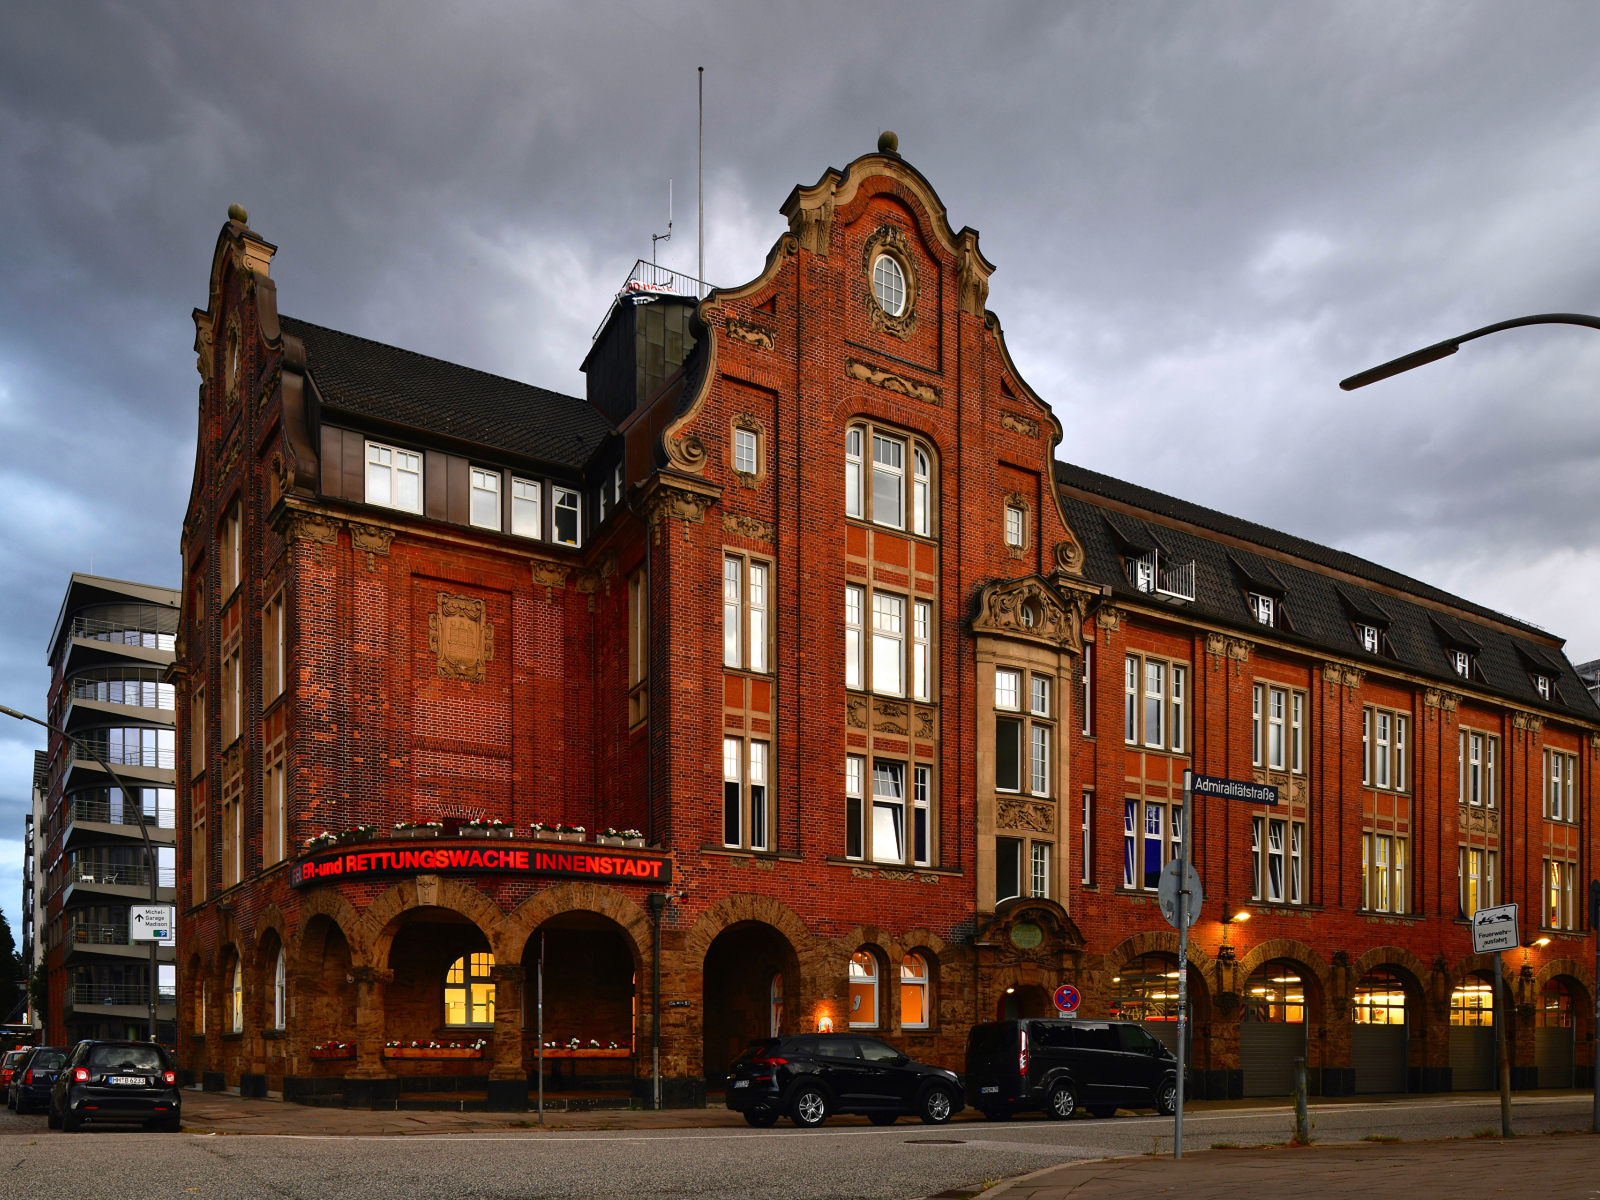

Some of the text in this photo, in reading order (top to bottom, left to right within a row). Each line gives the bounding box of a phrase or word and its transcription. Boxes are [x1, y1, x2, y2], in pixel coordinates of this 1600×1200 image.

[1195, 777, 1275, 801] Admiralitätstraße
[346, 849, 529, 873] RETTUNGSWACHE
[535, 852, 662, 878] INNENSTADT
[1478, 930, 1512, 939] Feuerwehr-
[1483, 936, 1508, 945] ausfahrt
